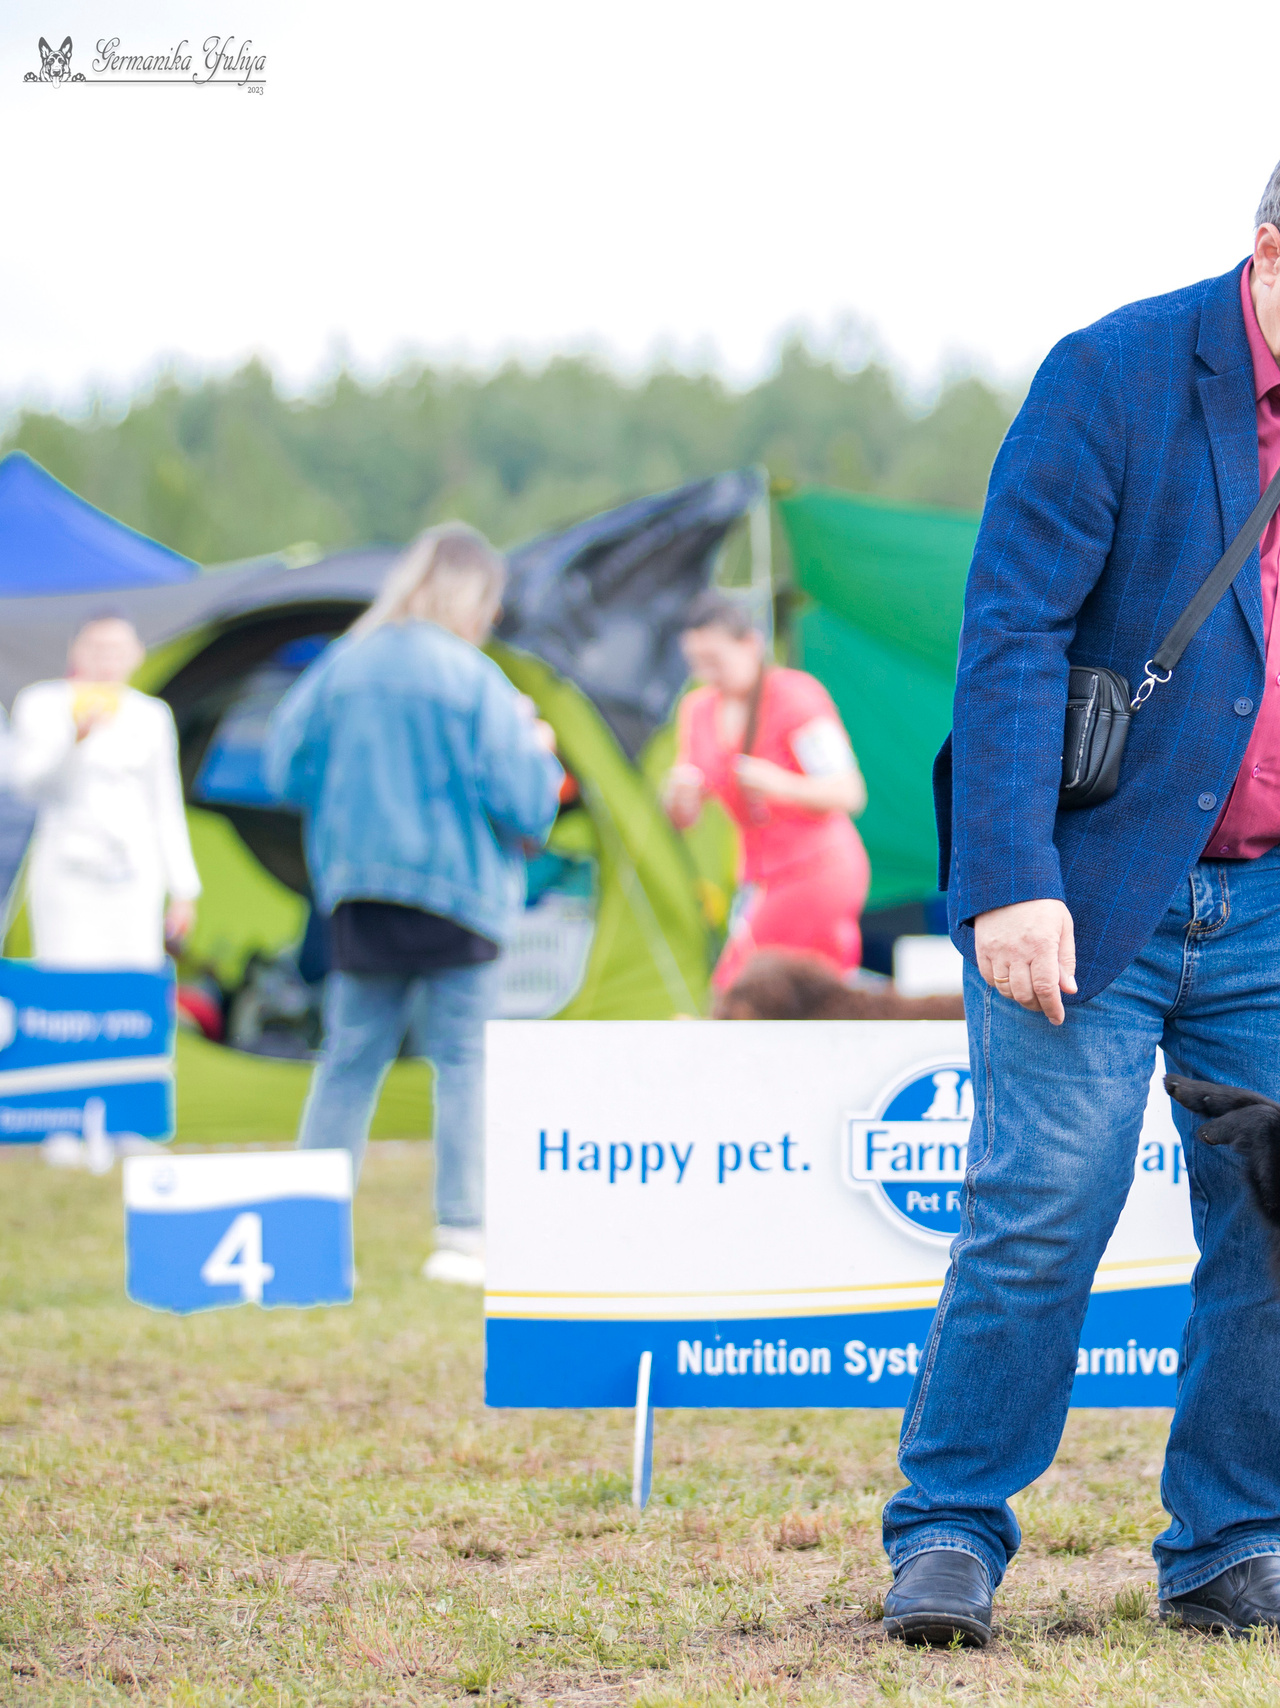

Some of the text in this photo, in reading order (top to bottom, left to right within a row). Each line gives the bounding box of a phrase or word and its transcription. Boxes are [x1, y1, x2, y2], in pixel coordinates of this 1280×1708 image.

[538, 1128, 811, 1184] Happy pet.
[865, 1129, 968, 1171] Farm
[906, 1190, 941, 1213] Pet
[200, 1210, 275, 1303] 4
[676, 1338, 926, 1384] Nutrition Syst
[1074, 1338, 1179, 1375] arnivo
